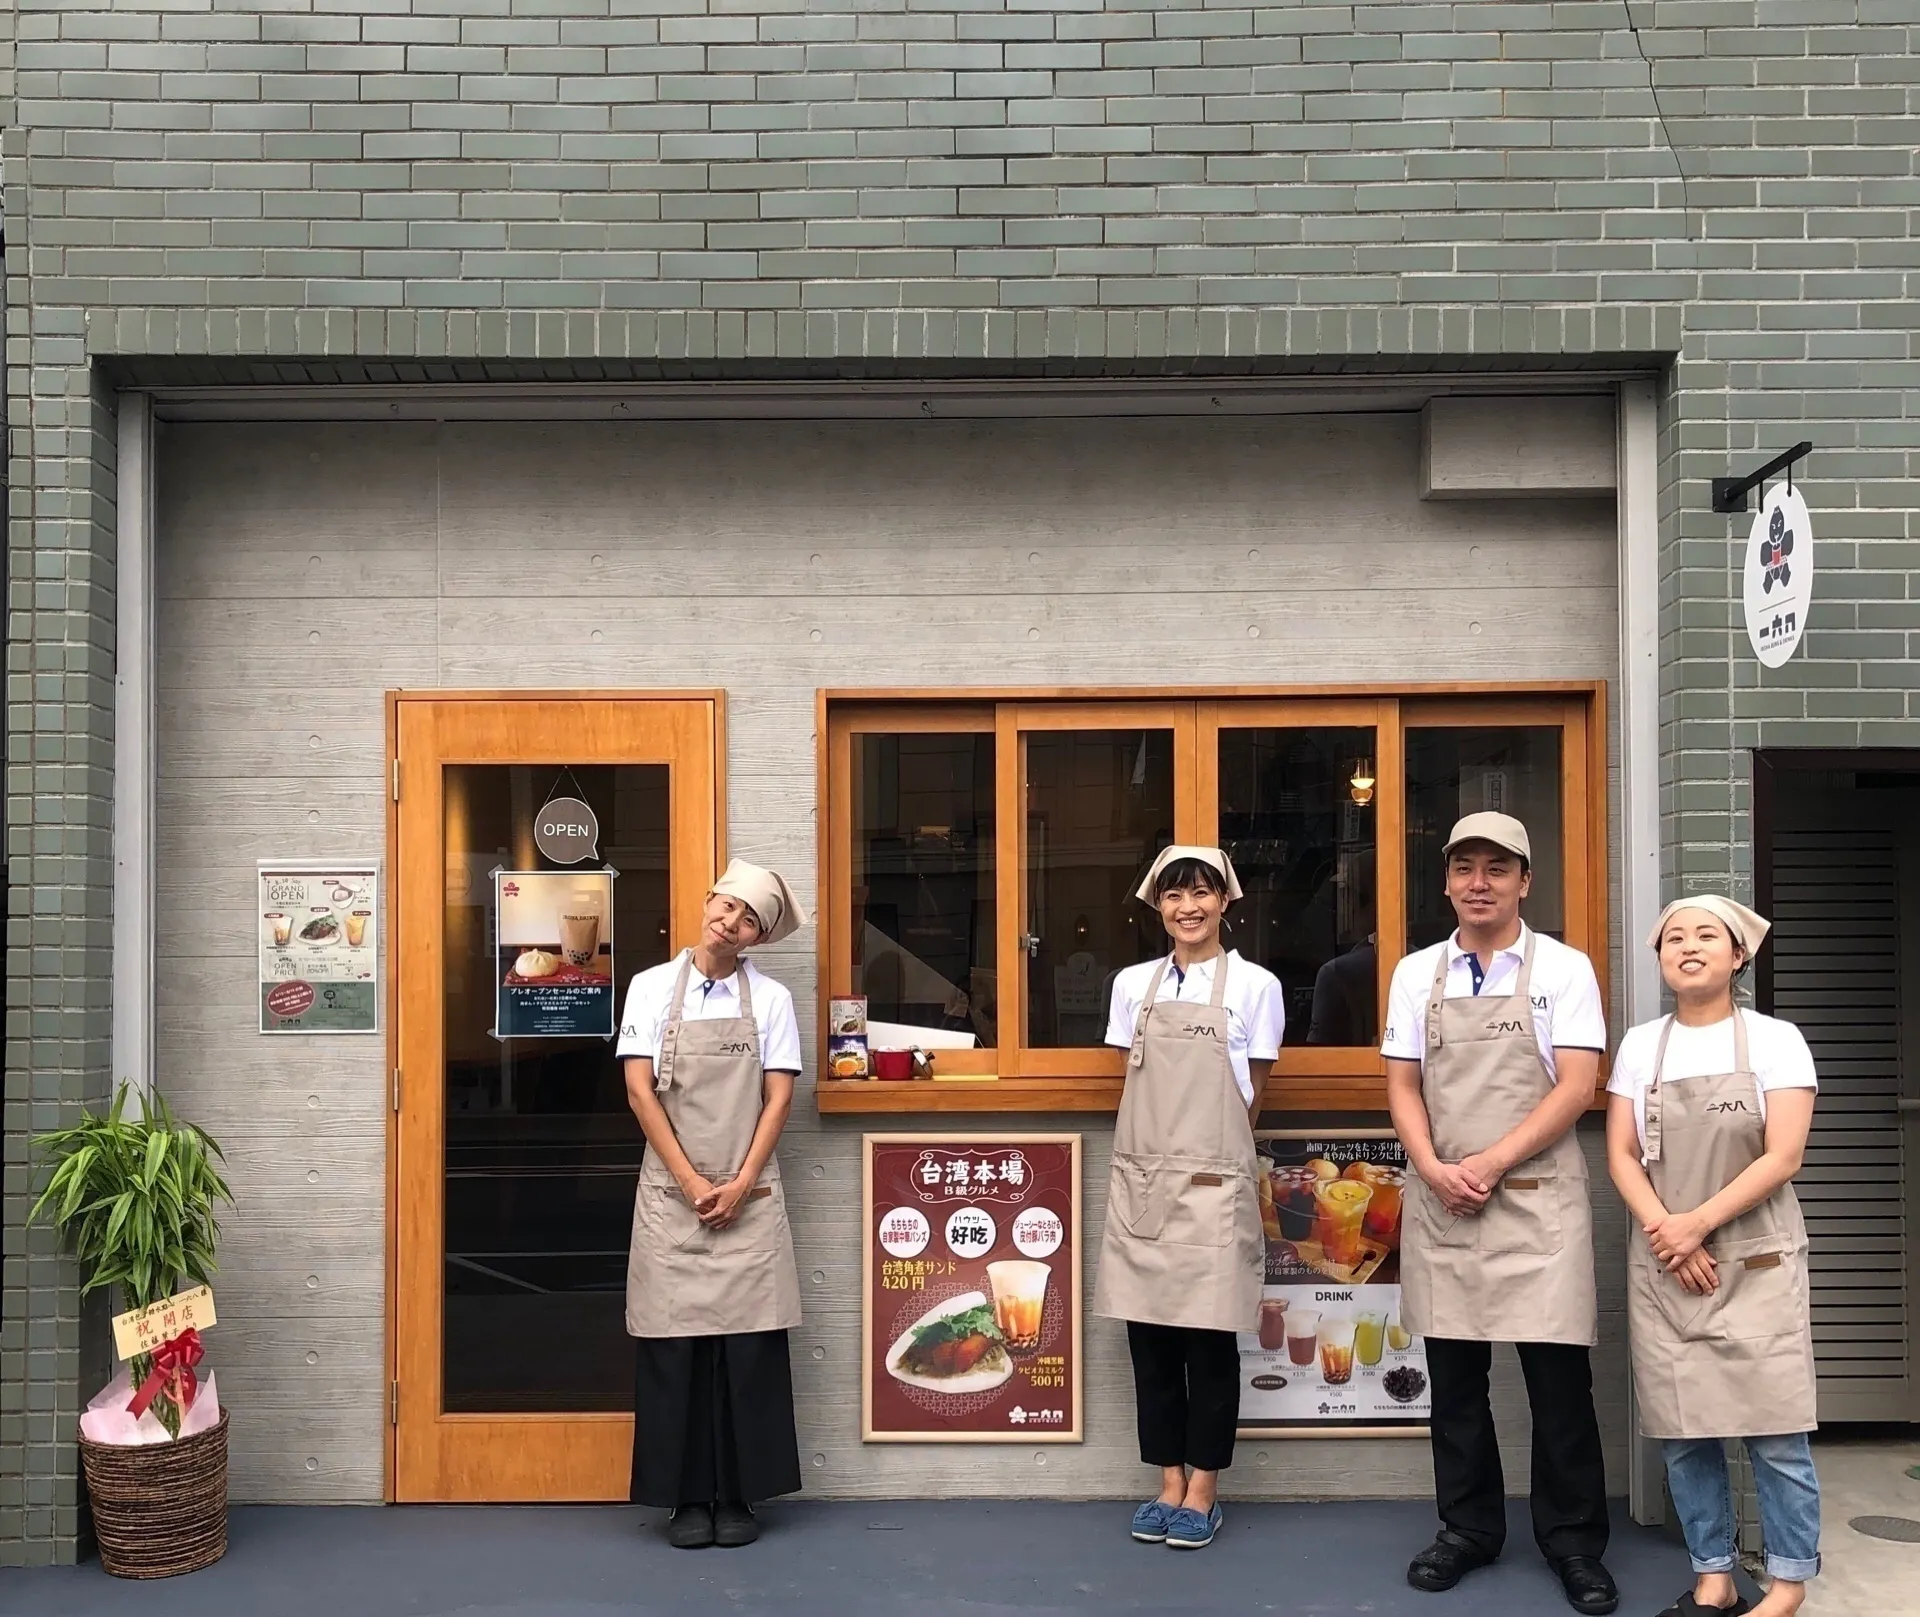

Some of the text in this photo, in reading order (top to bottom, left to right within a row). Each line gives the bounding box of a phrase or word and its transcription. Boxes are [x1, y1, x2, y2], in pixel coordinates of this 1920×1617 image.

[543, 823, 589, 837] OPEN
[270, 891, 304, 900] OPEN
[1183, 1026, 1217, 1037] 一六八
[1486, 1021, 1524, 1032] 一六八
[720, 1042, 752, 1052] 一六八
[1706, 1100, 1746, 1113] 一六八
[920, 1159, 1025, 1186] 台湾本場
[944, 1186, 1000, 1196] B級グルメ
[890, 1219, 919, 1230] もちもちの
[1014, 1220, 1061, 1230] ジューシーなとろける
[882, 1231, 927, 1244] 自家製中華バンズ
[951, 1225, 988, 1245] 好吃
[882, 1260, 956, 1276] 台湾角煮サンド
[882, 1276, 925, 1290] 420円
[1315, 1292, 1354, 1301] DRINK
[1018, 1366, 1064, 1374] タピオカミルク
[1030, 1376, 1064, 1388] 500円
